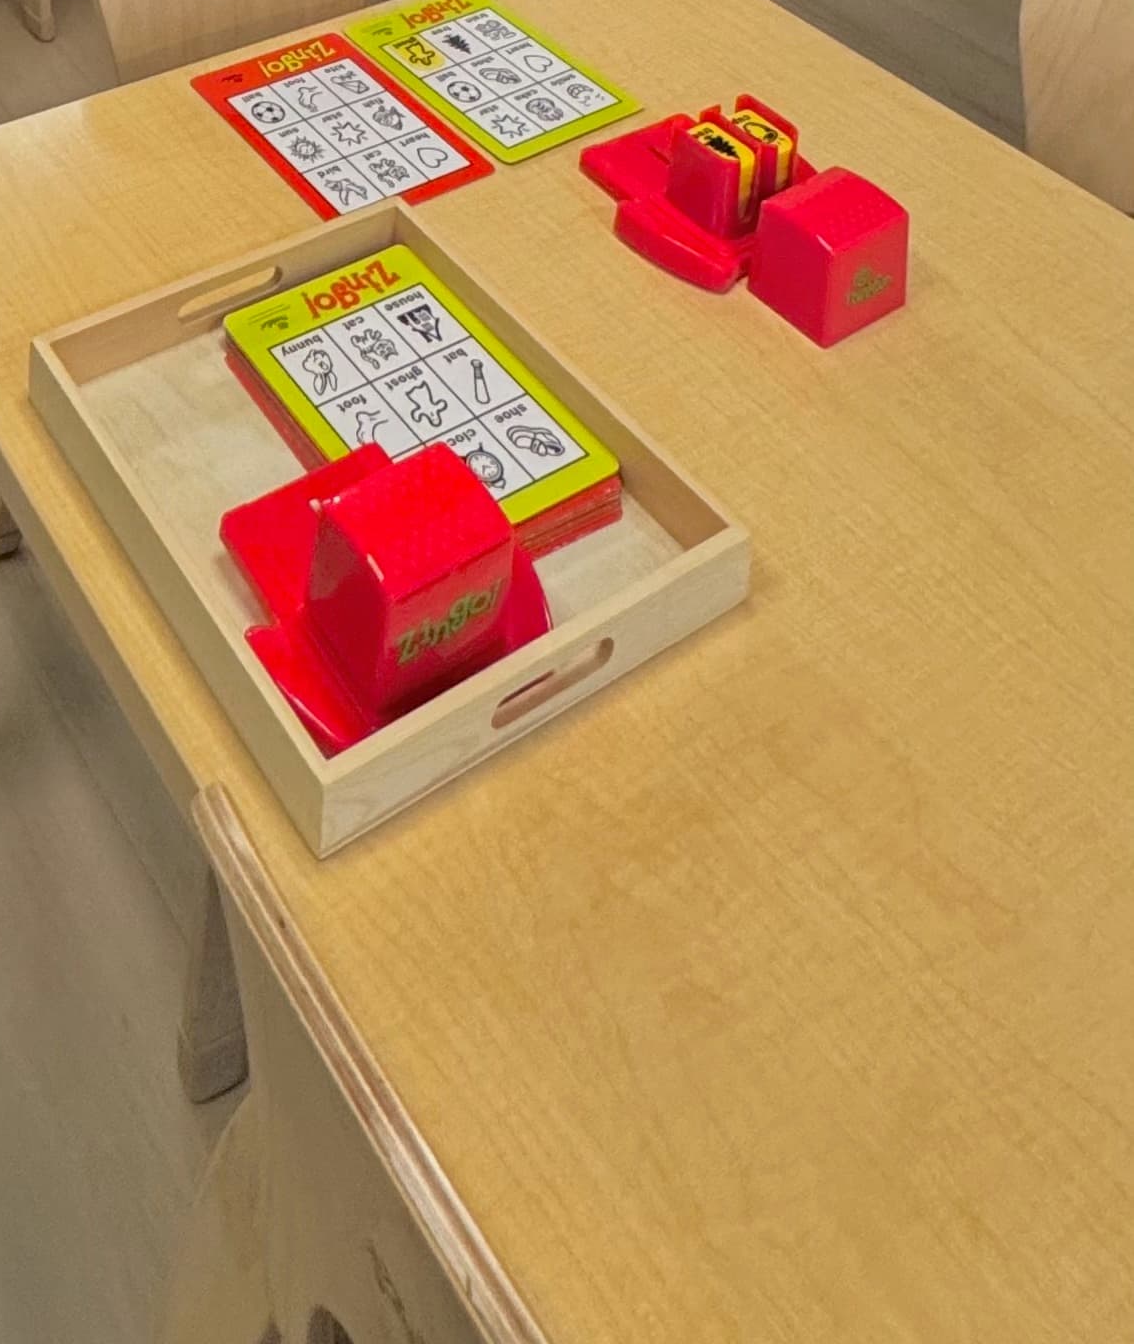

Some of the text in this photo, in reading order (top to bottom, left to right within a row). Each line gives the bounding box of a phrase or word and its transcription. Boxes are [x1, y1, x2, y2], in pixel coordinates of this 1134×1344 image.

[257, 40, 336, 78] Zingo!
[400, 133, 431, 147] heart
[362, 150, 382, 161] cat
[317, 165, 342, 179] bird
[300, 260, 401, 320] Zingo!
[384, 291, 425, 311] house
[342, 316, 365, 331] cat
[281, 335, 324, 356] bunny
[442, 348, 468, 363] bat
[384, 366, 424, 391] ghost
[336, 394, 367, 412] foot
[494, 404, 528, 424] shoe
[446, 428, 477, 447] cloc
[396, 578, 505, 666] Zingo!
